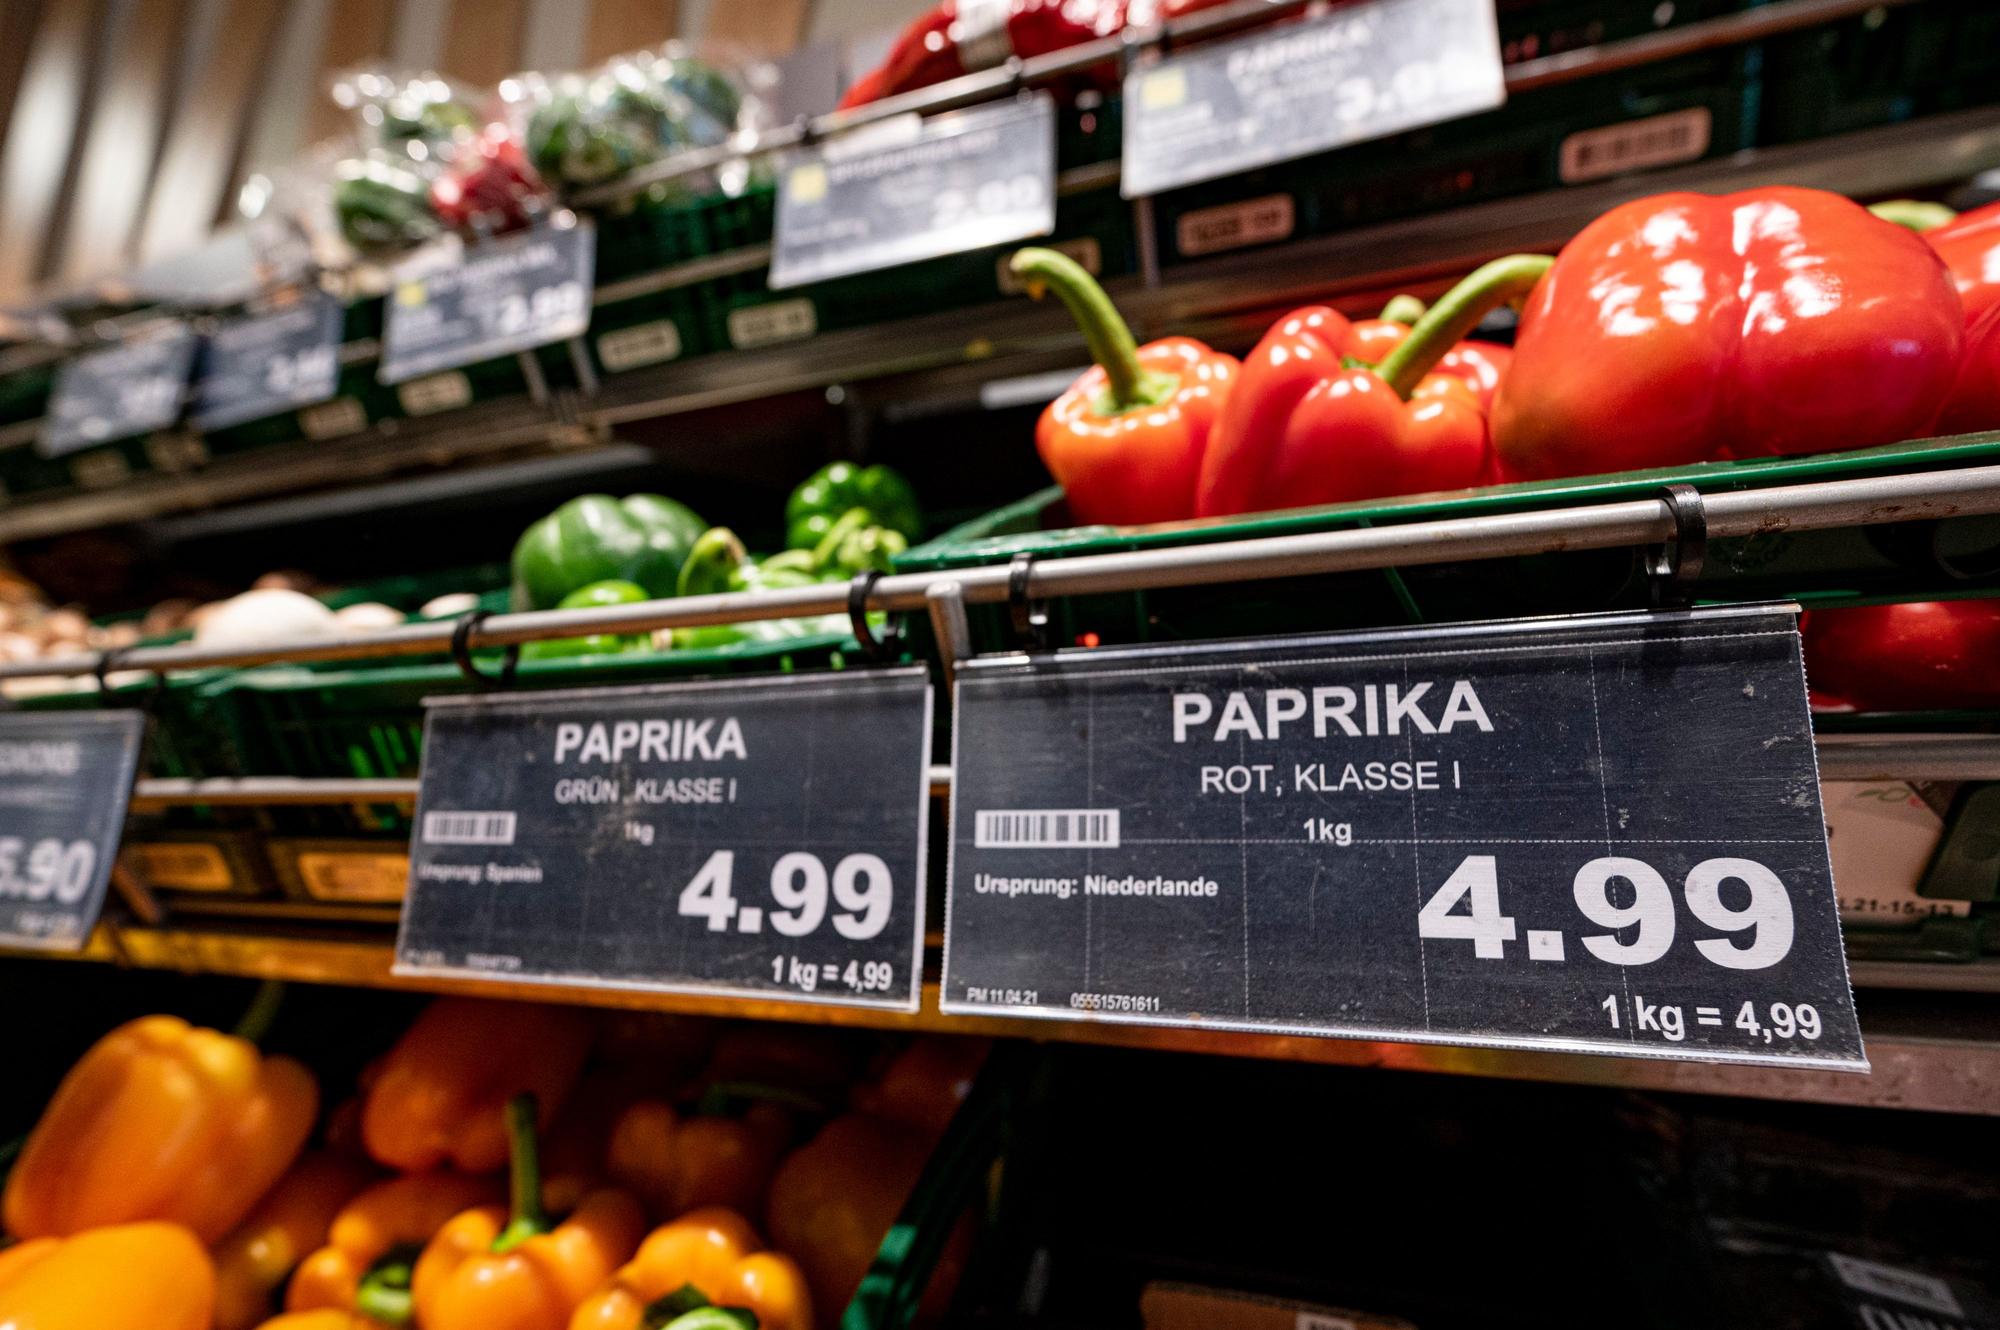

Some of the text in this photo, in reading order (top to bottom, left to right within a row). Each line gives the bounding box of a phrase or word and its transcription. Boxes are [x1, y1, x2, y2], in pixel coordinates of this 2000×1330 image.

[1173, 679, 1495, 743] PAPRIKA
[555, 717, 747, 764] PAPRIKA
[633, 777, 724, 804] KLASSE
[1201, 760, 1462, 797] ROT, KLASSE I
[1303, 817, 1354, 847] 1kg
[677, 850, 894, 941] 4.99
[974, 873, 1219, 900] Ursprung: Niederlande
[1417, 854, 1796, 971] 4.99
[788, 959, 819, 991] kg
[842, 960, 894, 993] 4,99
[1602, 994, 1823, 1045] 1 kg = 4,99
